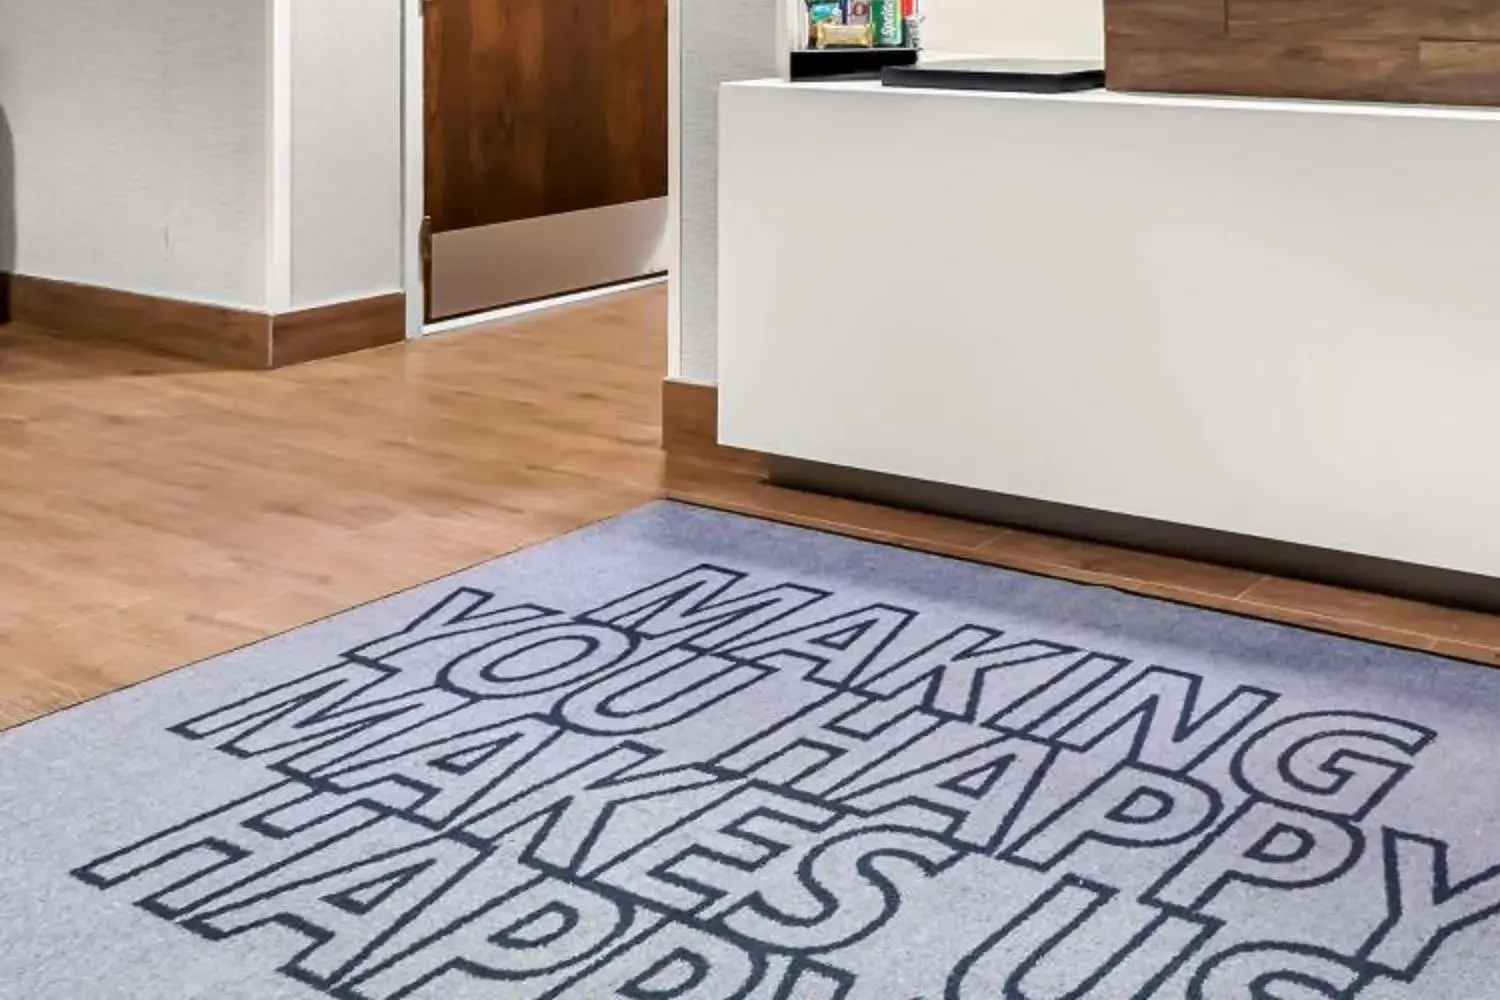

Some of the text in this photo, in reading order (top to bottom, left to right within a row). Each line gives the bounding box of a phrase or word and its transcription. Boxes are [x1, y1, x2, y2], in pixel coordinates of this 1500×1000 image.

[339, 586, 781, 736] YOU
[572, 563, 1438, 822] MAKING
[69, 780, 924, 1000] HAPP
[166, 658, 972, 957] MAKES
